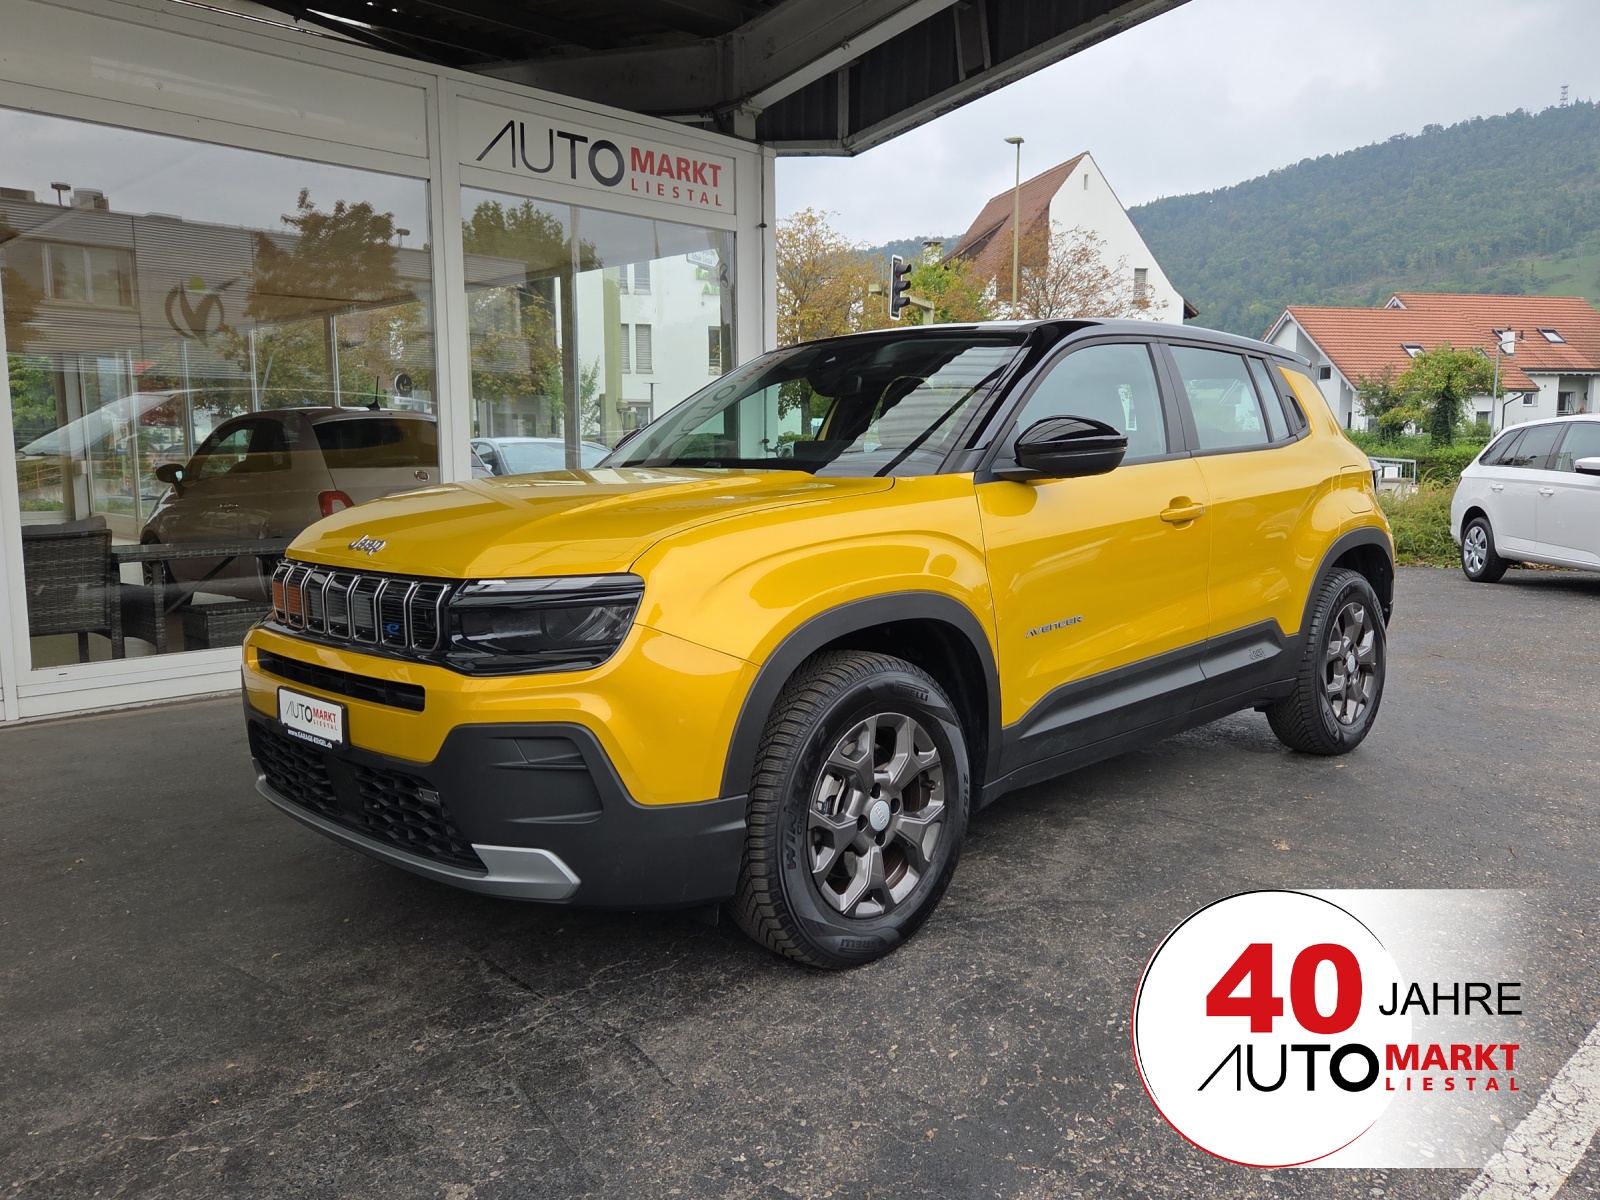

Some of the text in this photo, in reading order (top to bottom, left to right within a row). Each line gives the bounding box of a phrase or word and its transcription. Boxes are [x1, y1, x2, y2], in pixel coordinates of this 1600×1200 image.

[475, 119, 722, 188] AUTO MARKT
[631, 177, 722, 207] LIESTAL
[348, 534, 387, 556] Jeep
[1025, 615, 1083, 639] AVENGER
[285, 700, 337, 724] AUTO MARKT
[313, 719, 338, 731] LIESTAL
